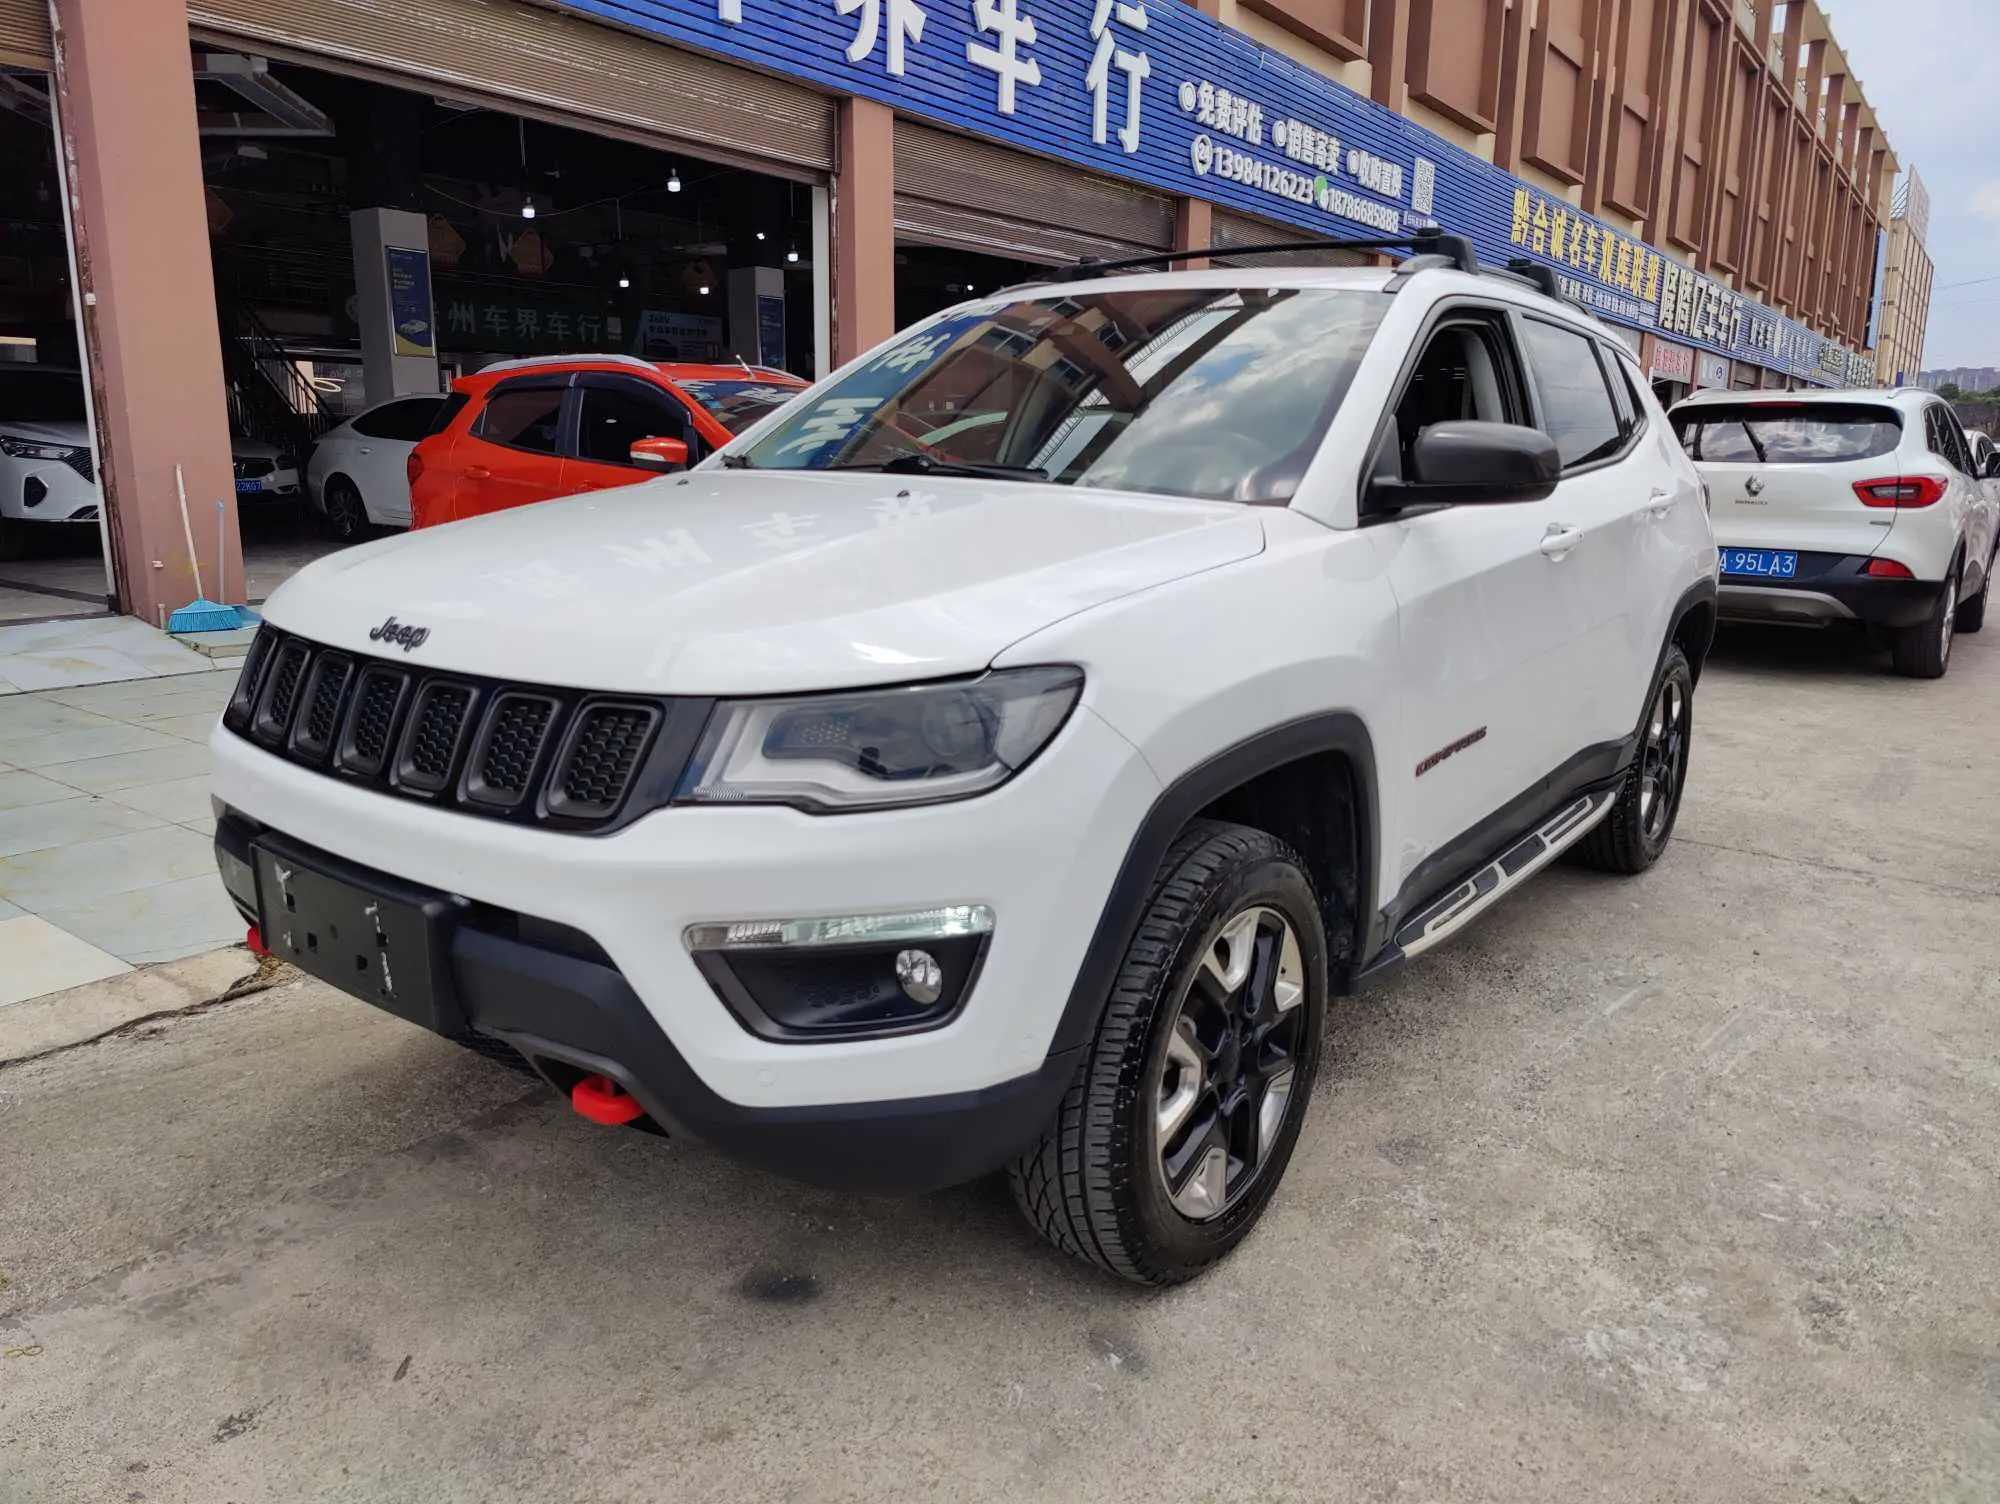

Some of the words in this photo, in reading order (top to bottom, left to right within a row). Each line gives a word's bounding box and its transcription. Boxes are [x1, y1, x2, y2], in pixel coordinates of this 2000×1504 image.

[718, 0, 1153, 154] 车行
[1197, 80, 1264, 146] 免费评估
[1286, 118, 1341, 175] 销售寄卖
[1358, 150, 1402, 199] 收购置换
[1213, 146, 1315, 205] 13984126223
[433, 300, 601, 343] 州车界车行
[369, 616, 431, 652] Jeep
